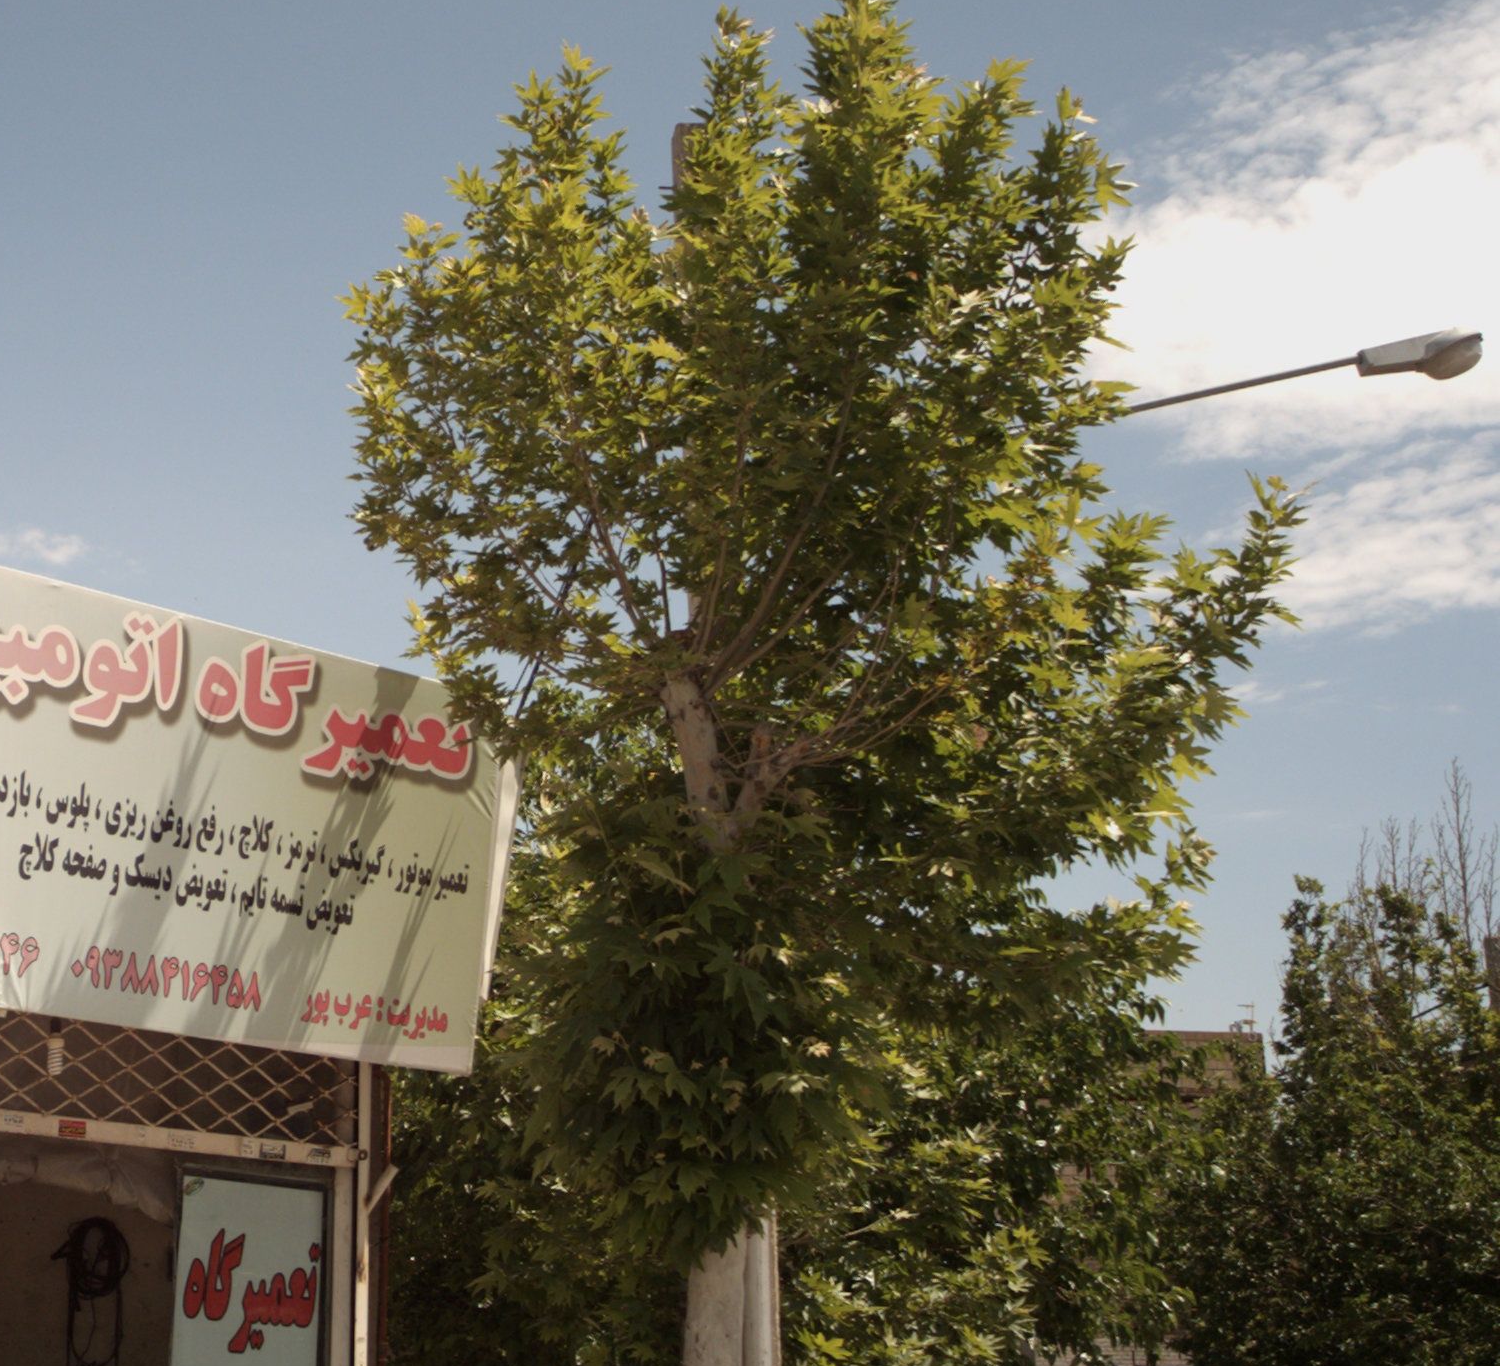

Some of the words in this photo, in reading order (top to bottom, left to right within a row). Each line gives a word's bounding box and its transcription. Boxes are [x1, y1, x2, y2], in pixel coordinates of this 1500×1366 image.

[195, 639, 317, 735] گاه
[45, 781, 90, 833] پلوس
[105, 798, 147, 841] ریزی
[150, 799, 192, 849] روغن
[195, 805, 224, 856] رفع
[237, 814, 274, 860] کلاچ
[283, 830, 319, 873] ترمز
[18, 831, 60, 881] کلاچ
[61, 843, 107, 881] صفحه
[108, 860, 120, 896] و
[124, 852, 172, 901] دیسک
[328, 836, 386, 885] گیربکس
[394, 852, 432, 897] موتور
[174, 863, 228, 912] تعویض
[238, 874, 268, 917] تایم
[270, 884, 305, 916] تسمه
[433, 864, 470, 901] تعمیر
[305, 888, 356, 935] تعویض
[70, 945, 262, 1012] ۰۹۳۸۸۴۱۶۴۵۸
[301, 988, 331, 1026] پور
[332, 992, 373, 1030] عرب
[386, 997, 449, 1039] مدیریت
[182, 1228, 246, 1322] گاه
[228, 1242, 322, 1354] تعمیر
